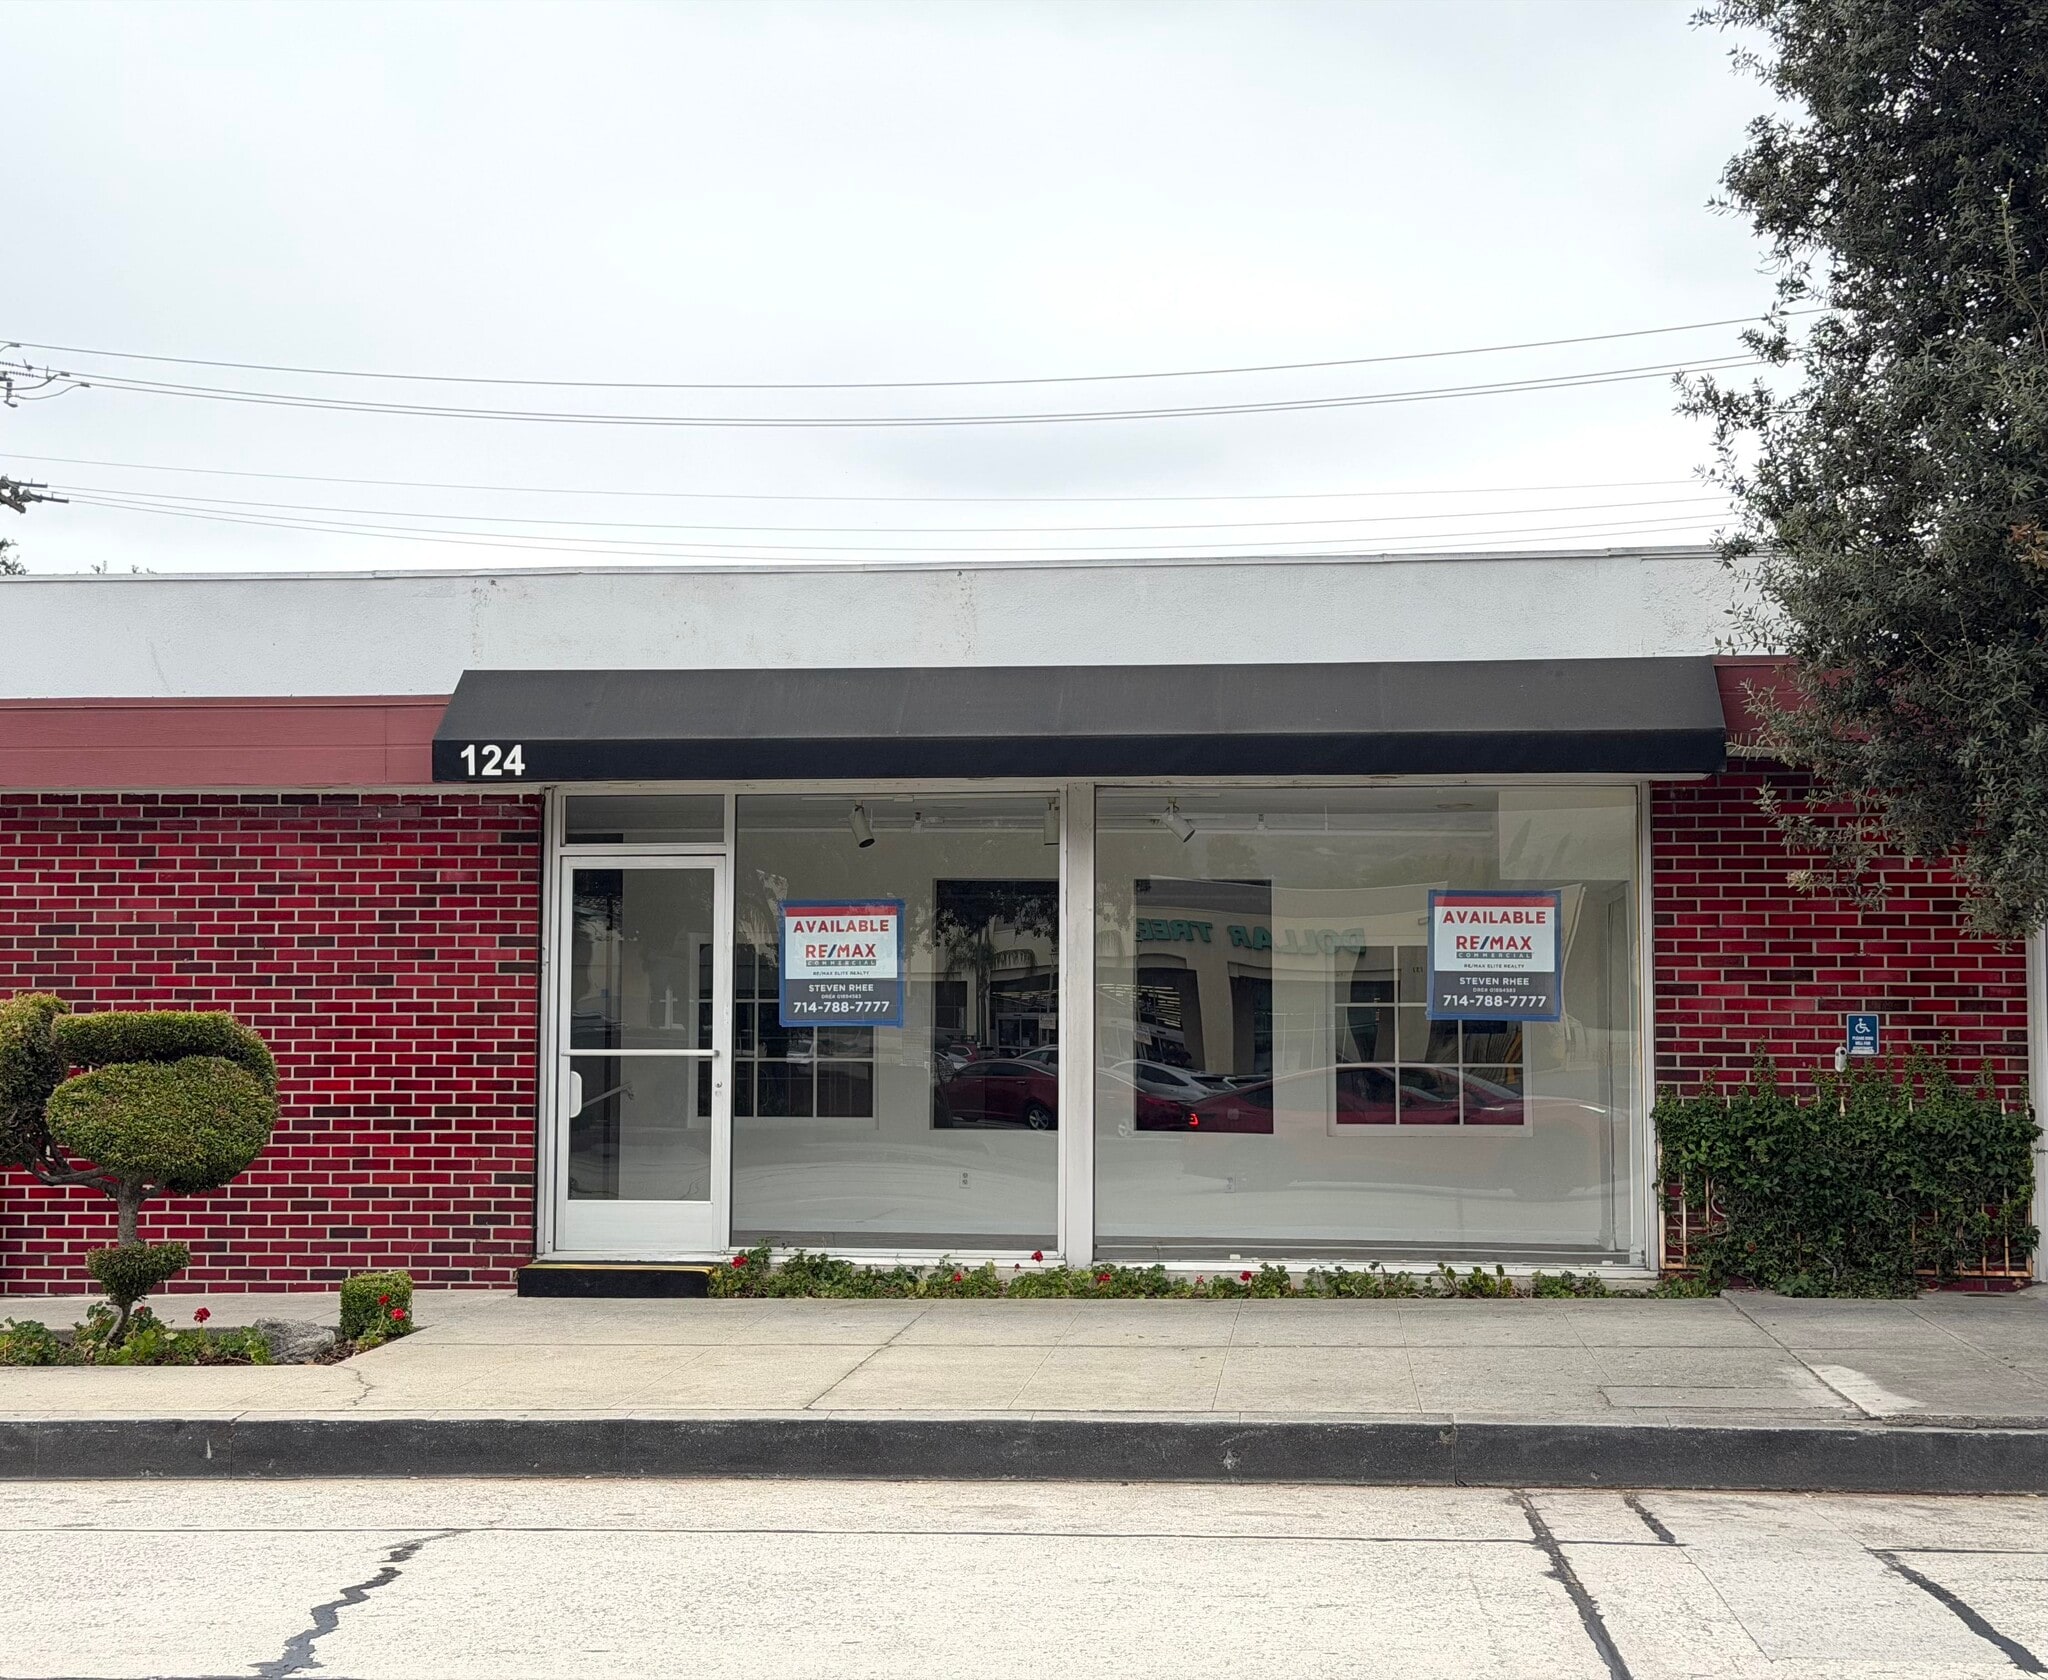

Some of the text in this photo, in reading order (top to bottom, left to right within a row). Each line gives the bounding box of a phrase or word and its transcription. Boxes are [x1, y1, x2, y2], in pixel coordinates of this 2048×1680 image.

[460, 744, 526, 776] 124
[1442, 911, 1546, 924] AVAILABLE
[793, 919, 890, 934] AVAILABLE
[1456, 936, 1532, 950] RE/MAX
[805, 944, 877, 959] RE/MAX
[808, 983, 874, 992] STEVEN RHEE
[1459, 977, 1530, 986] STEVEN RHEE
[793, 1001, 890, 1013] 714-788-7777
[1442, 995, 1547, 1007] 714-788-7777
